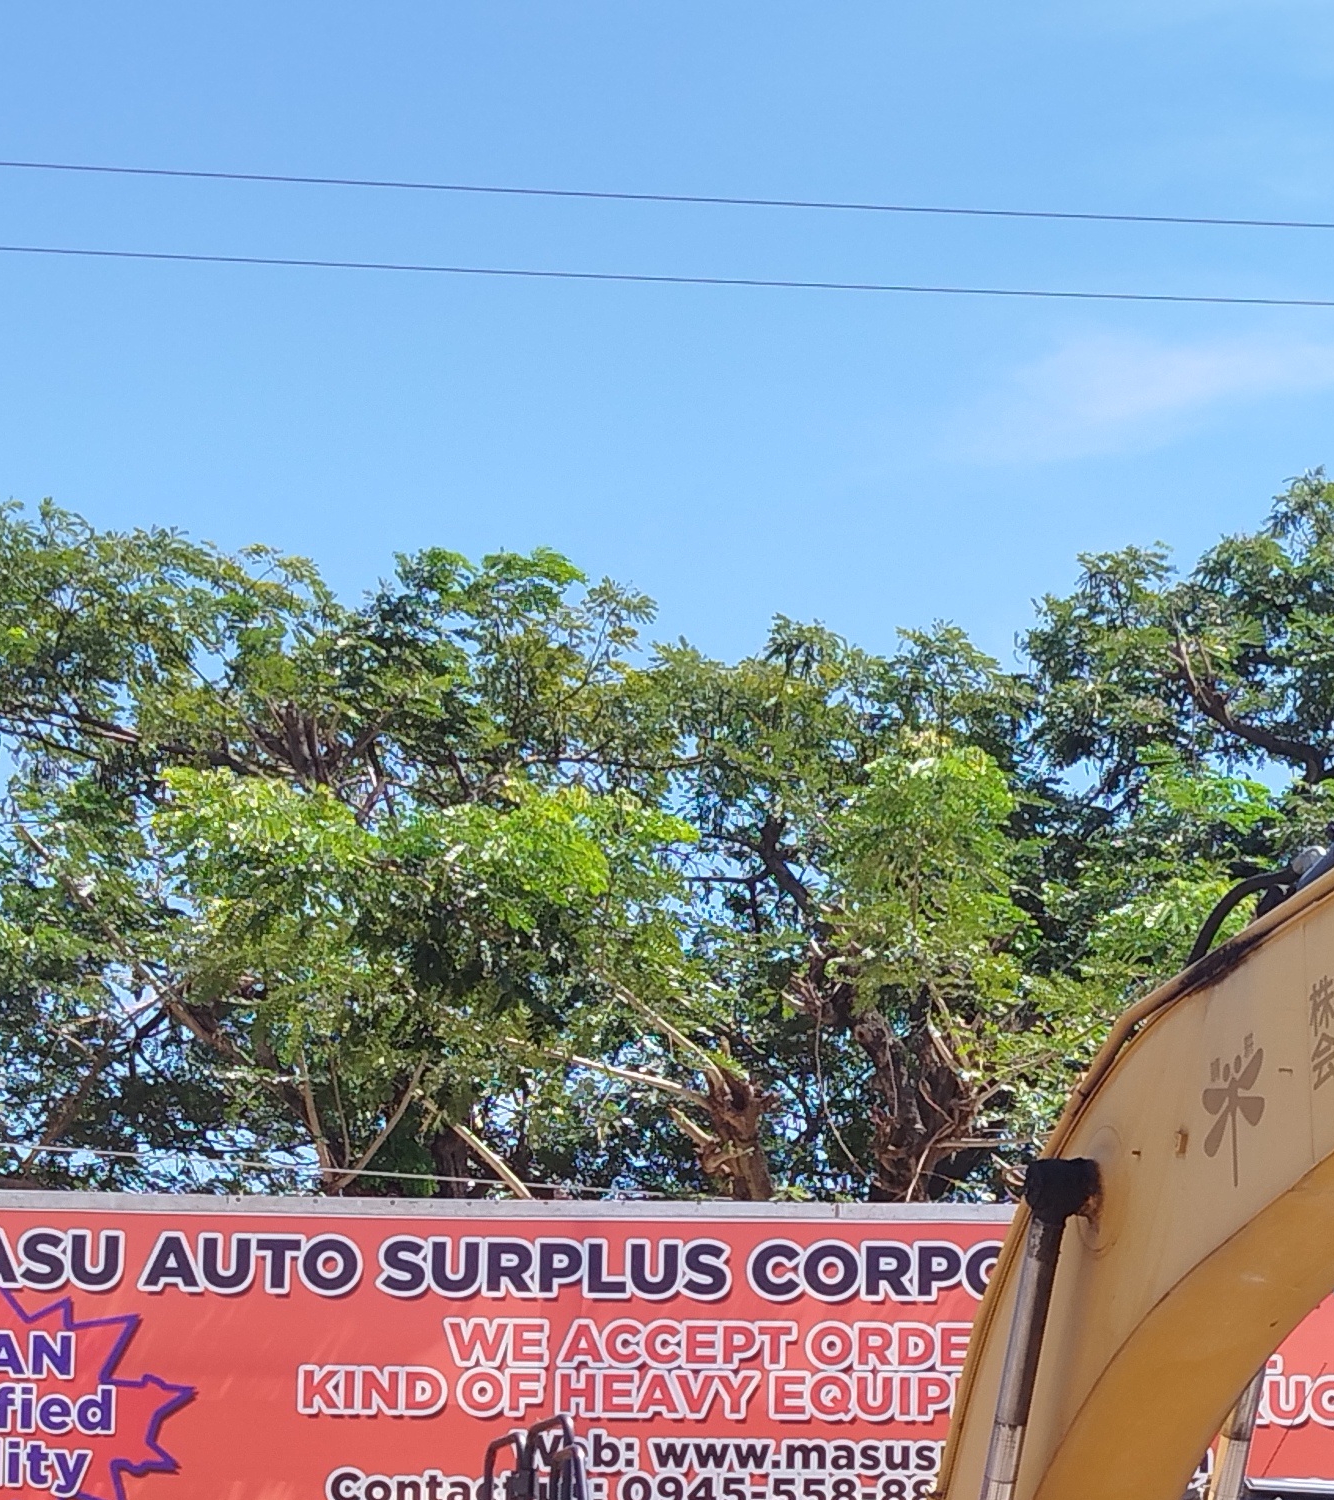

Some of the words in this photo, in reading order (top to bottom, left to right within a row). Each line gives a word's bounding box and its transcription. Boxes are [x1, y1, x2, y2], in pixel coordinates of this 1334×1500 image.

[137, 1231, 362, 1297] AUTO
[378, 1235, 732, 1301] SURPLUS
[443, 1317, 550, 1368] WE
[556, 1318, 798, 1371] ACCEPT
[297, 1364, 448, 1416] KIND
[456, 1367, 546, 1418] OF
[554, 1369, 760, 1419] HEAVY
[769, 1371, 961, 1422] EQUIP
[509, 1428, 640, 1474] Wb:
[648, 1437, 946, 1477] www.masus
